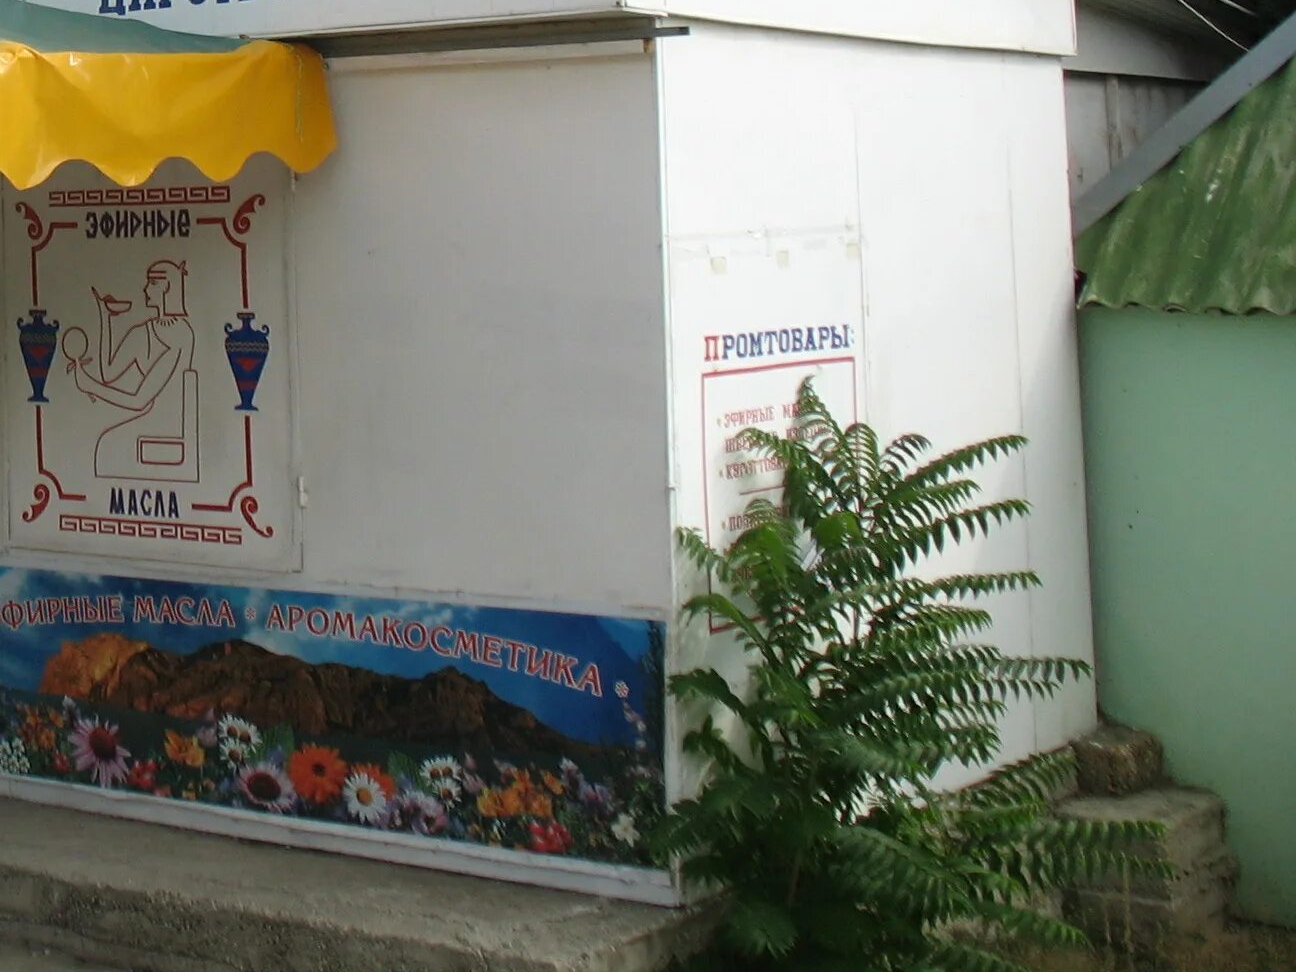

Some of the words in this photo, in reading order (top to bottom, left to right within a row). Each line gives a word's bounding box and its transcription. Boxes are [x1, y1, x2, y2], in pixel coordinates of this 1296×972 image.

[109, 487, 180, 519] МАСЛА
[133, 594, 236, 628] МАСЛА
[266, 603, 604, 696] АРОМАКОСМЕТИКА
